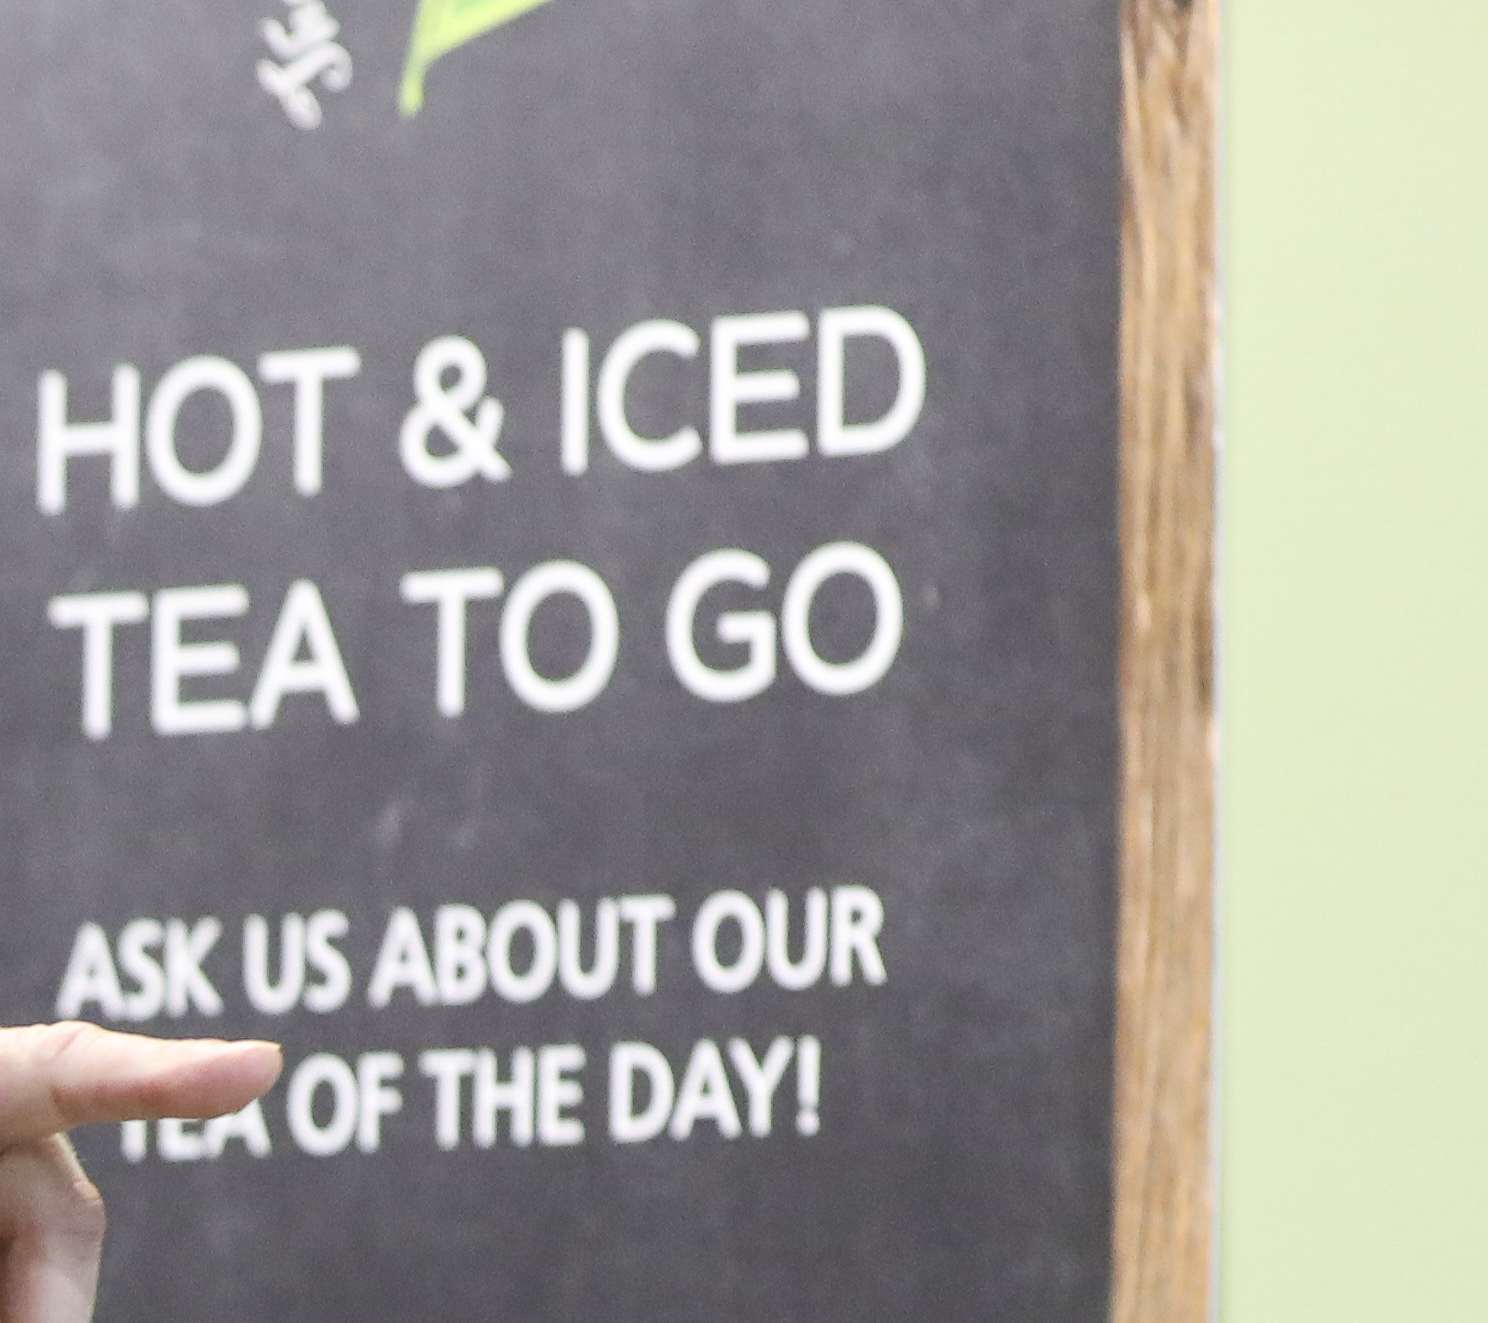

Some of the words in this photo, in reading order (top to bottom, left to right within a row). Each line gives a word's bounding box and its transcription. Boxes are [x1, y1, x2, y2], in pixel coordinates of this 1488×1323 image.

[36, 347, 360, 516] HOT
[399, 335, 510, 489] &
[560, 304, 927, 475] ICED
[48, 578, 360, 741] TEA
[399, 560, 620, 717] TO
[664, 541, 905, 703] GO
[55, 918, 223, 1021] ASK
[242, 910, 351, 1015] US
[368, 893, 676, 1010] ABOUT
[691, 884, 889, 994] OUR
[286, 1052, 405, 1157] OF
[419, 1044, 586, 1151] THE
[607, 1035, 824, 1143] DAY!
